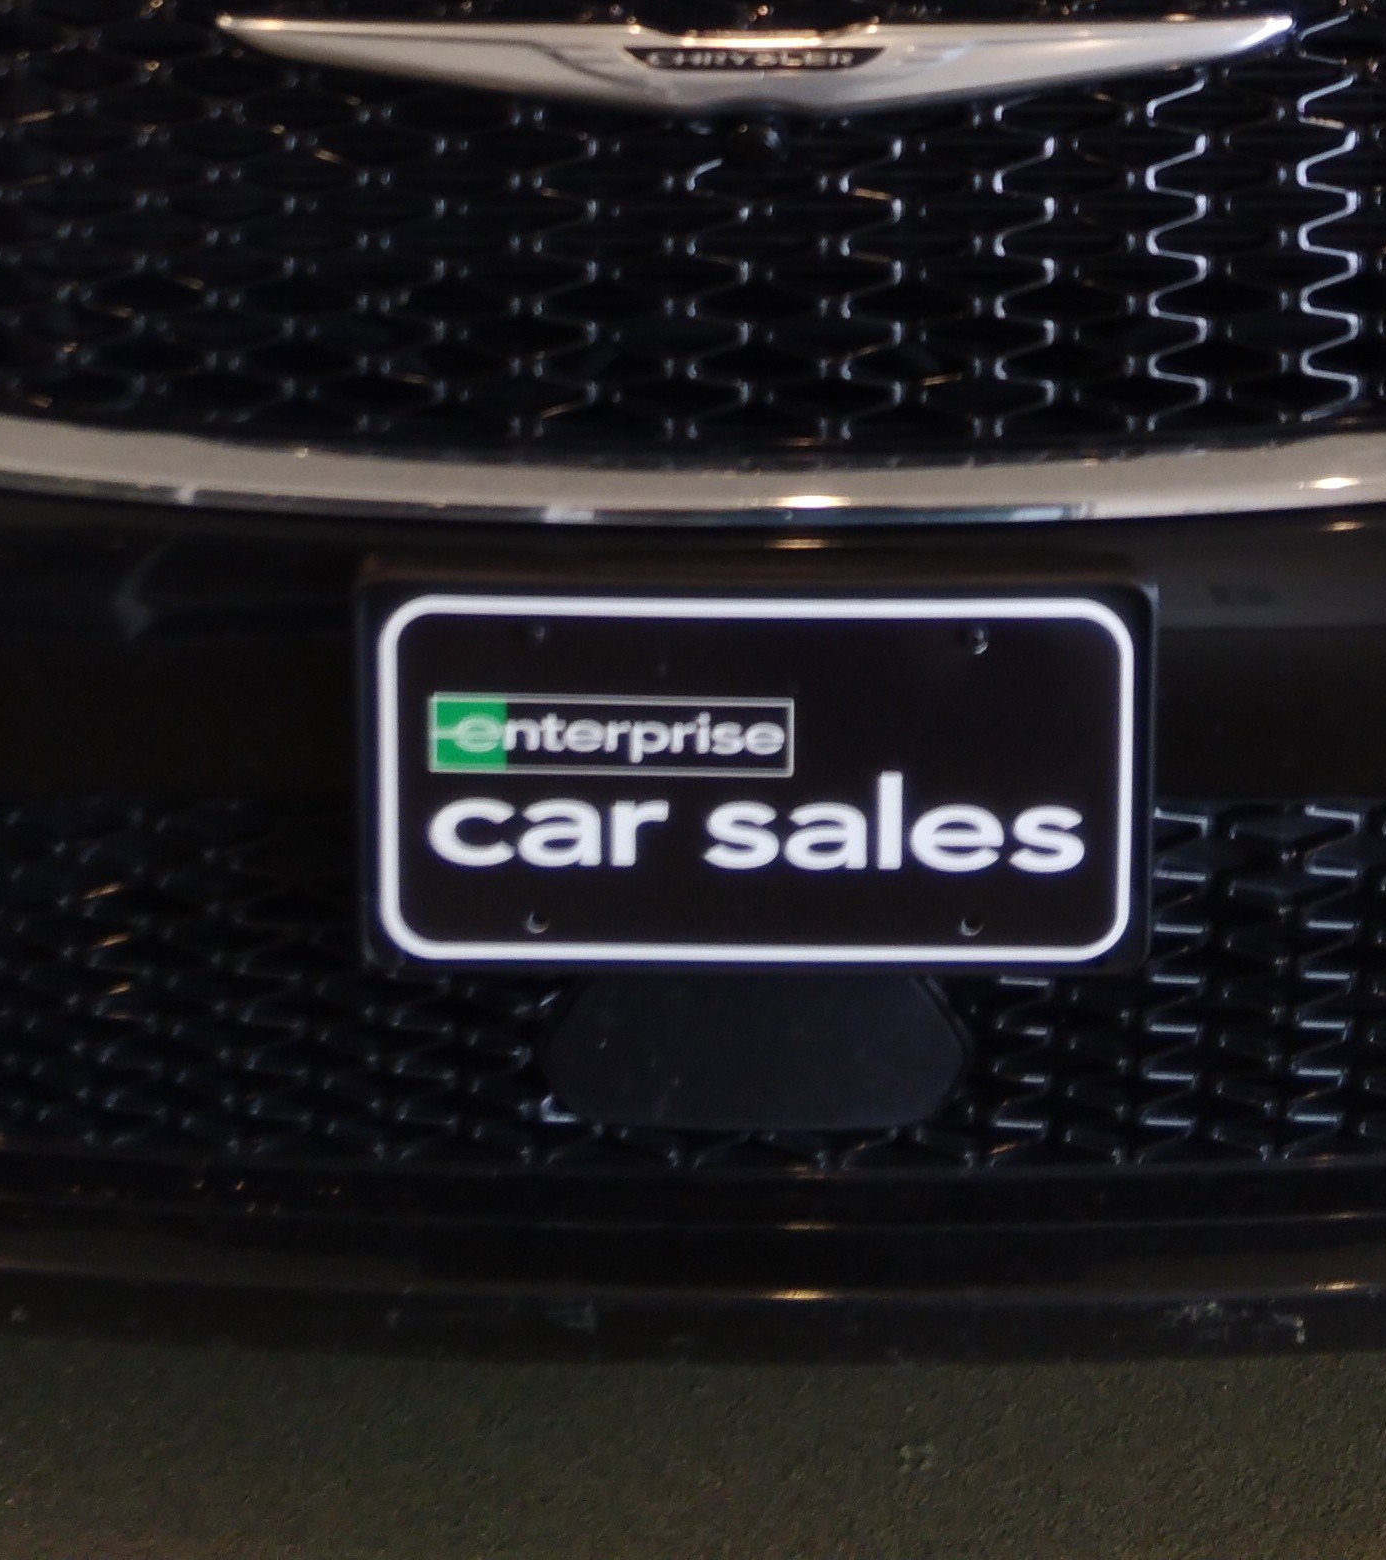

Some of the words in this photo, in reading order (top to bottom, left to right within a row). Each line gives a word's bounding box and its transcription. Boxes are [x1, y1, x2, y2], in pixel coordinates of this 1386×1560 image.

[437, 711, 786, 764] enterprise
[428, 796, 670, 867] car
[702, 770, 1085, 873] sales
